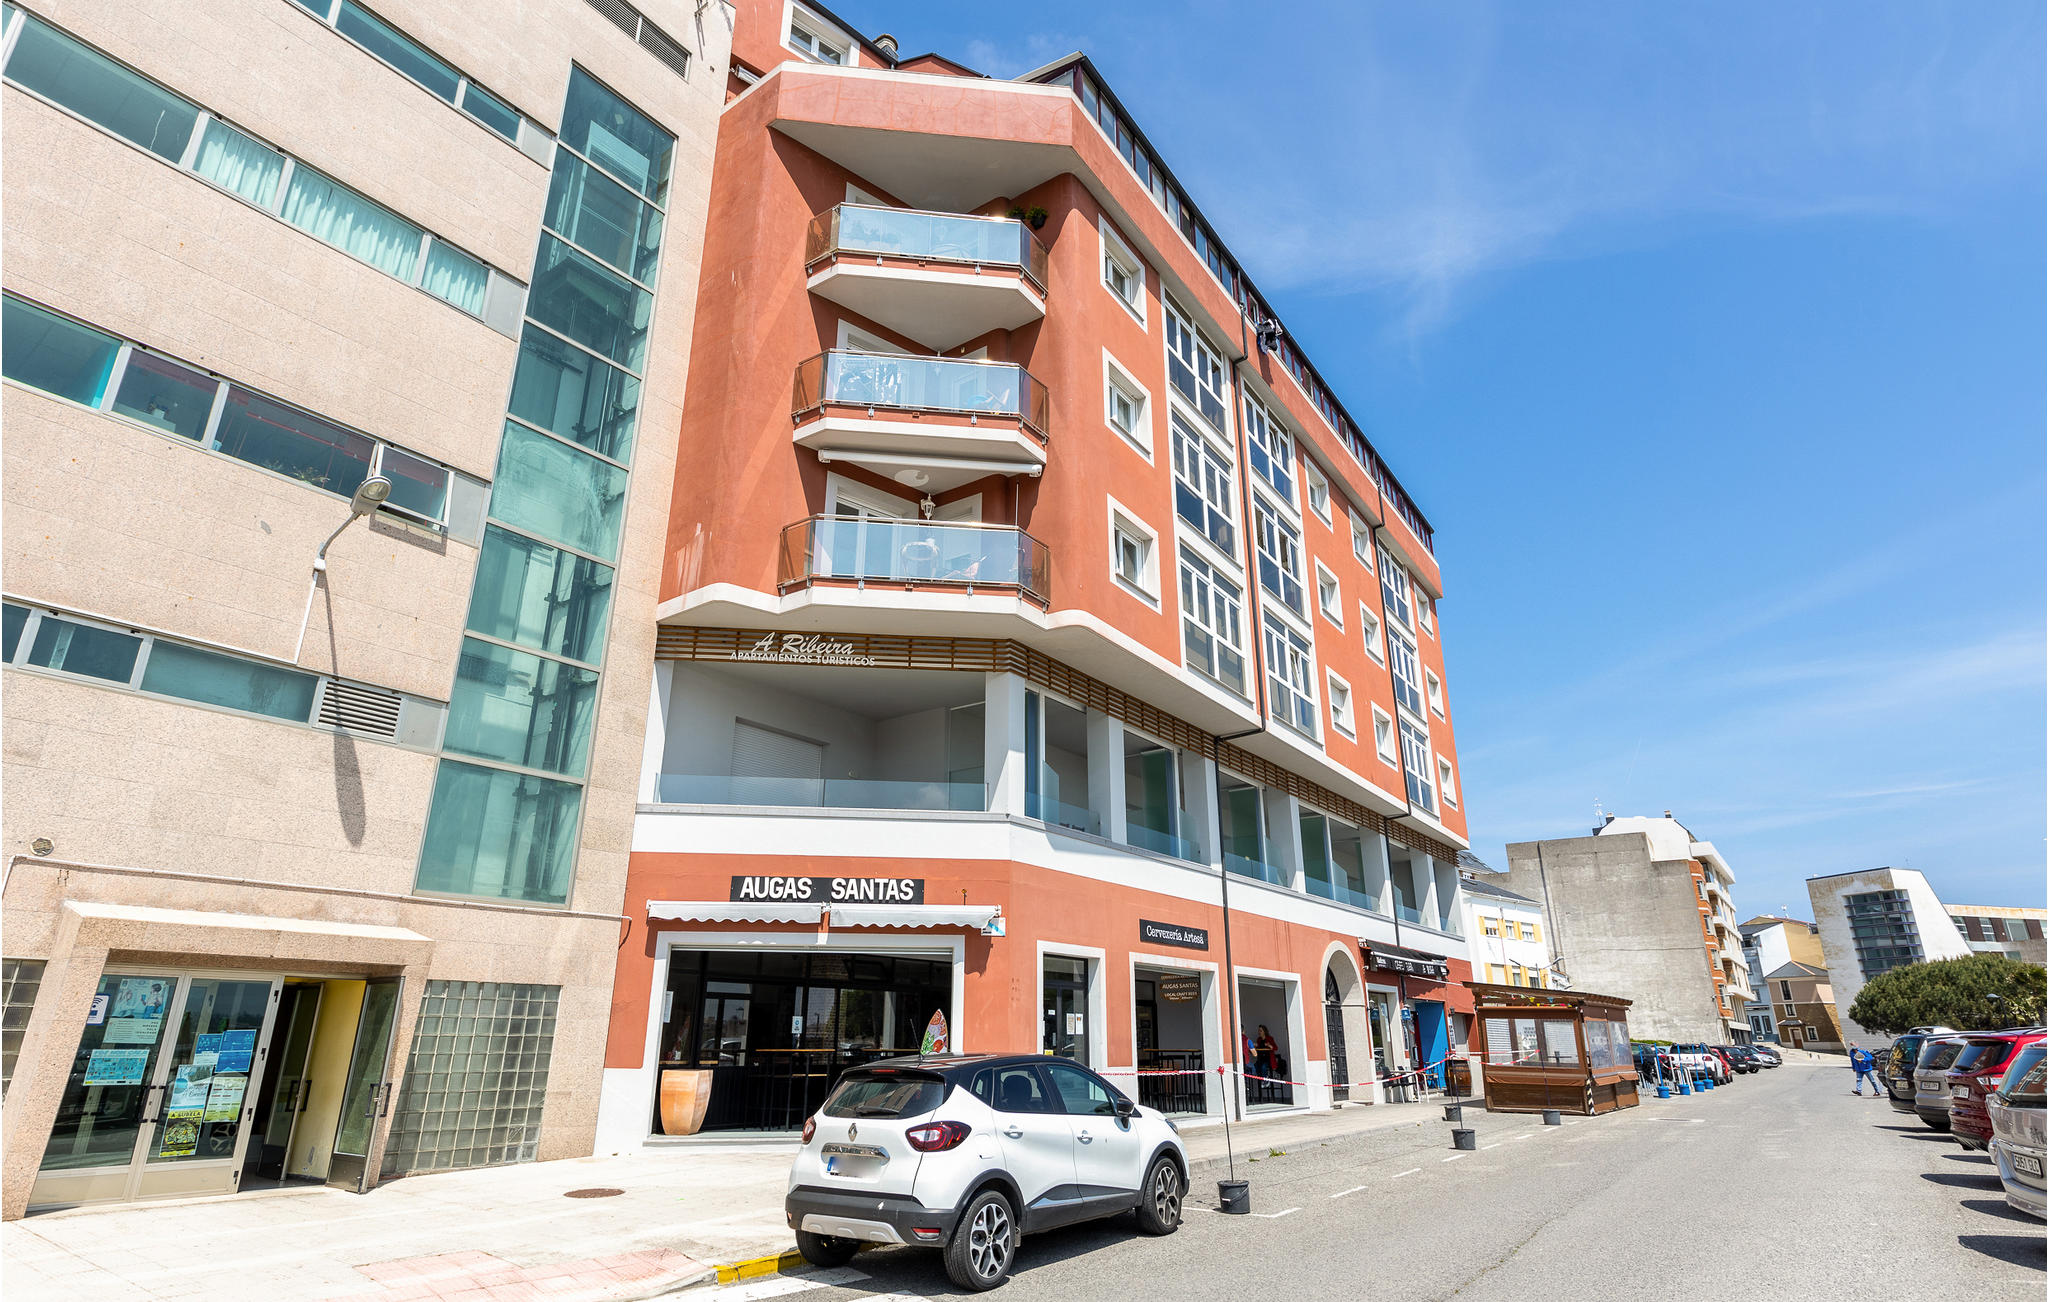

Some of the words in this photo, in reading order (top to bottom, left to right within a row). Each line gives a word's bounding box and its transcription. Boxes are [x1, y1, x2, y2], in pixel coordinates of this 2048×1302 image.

[752, 632, 775, 652] A
[780, 634, 855, 655] Ribeira
[729, 651, 813, 663] APARTAMENTOS
[816, 655, 876, 666] TURISTICOS
[740, 877, 812, 899] AUGAS
[831, 878, 914, 901] SANTAS
[1146, 925, 1183, 941] Cervexería
[1183, 931, 1204, 944] Artesá
